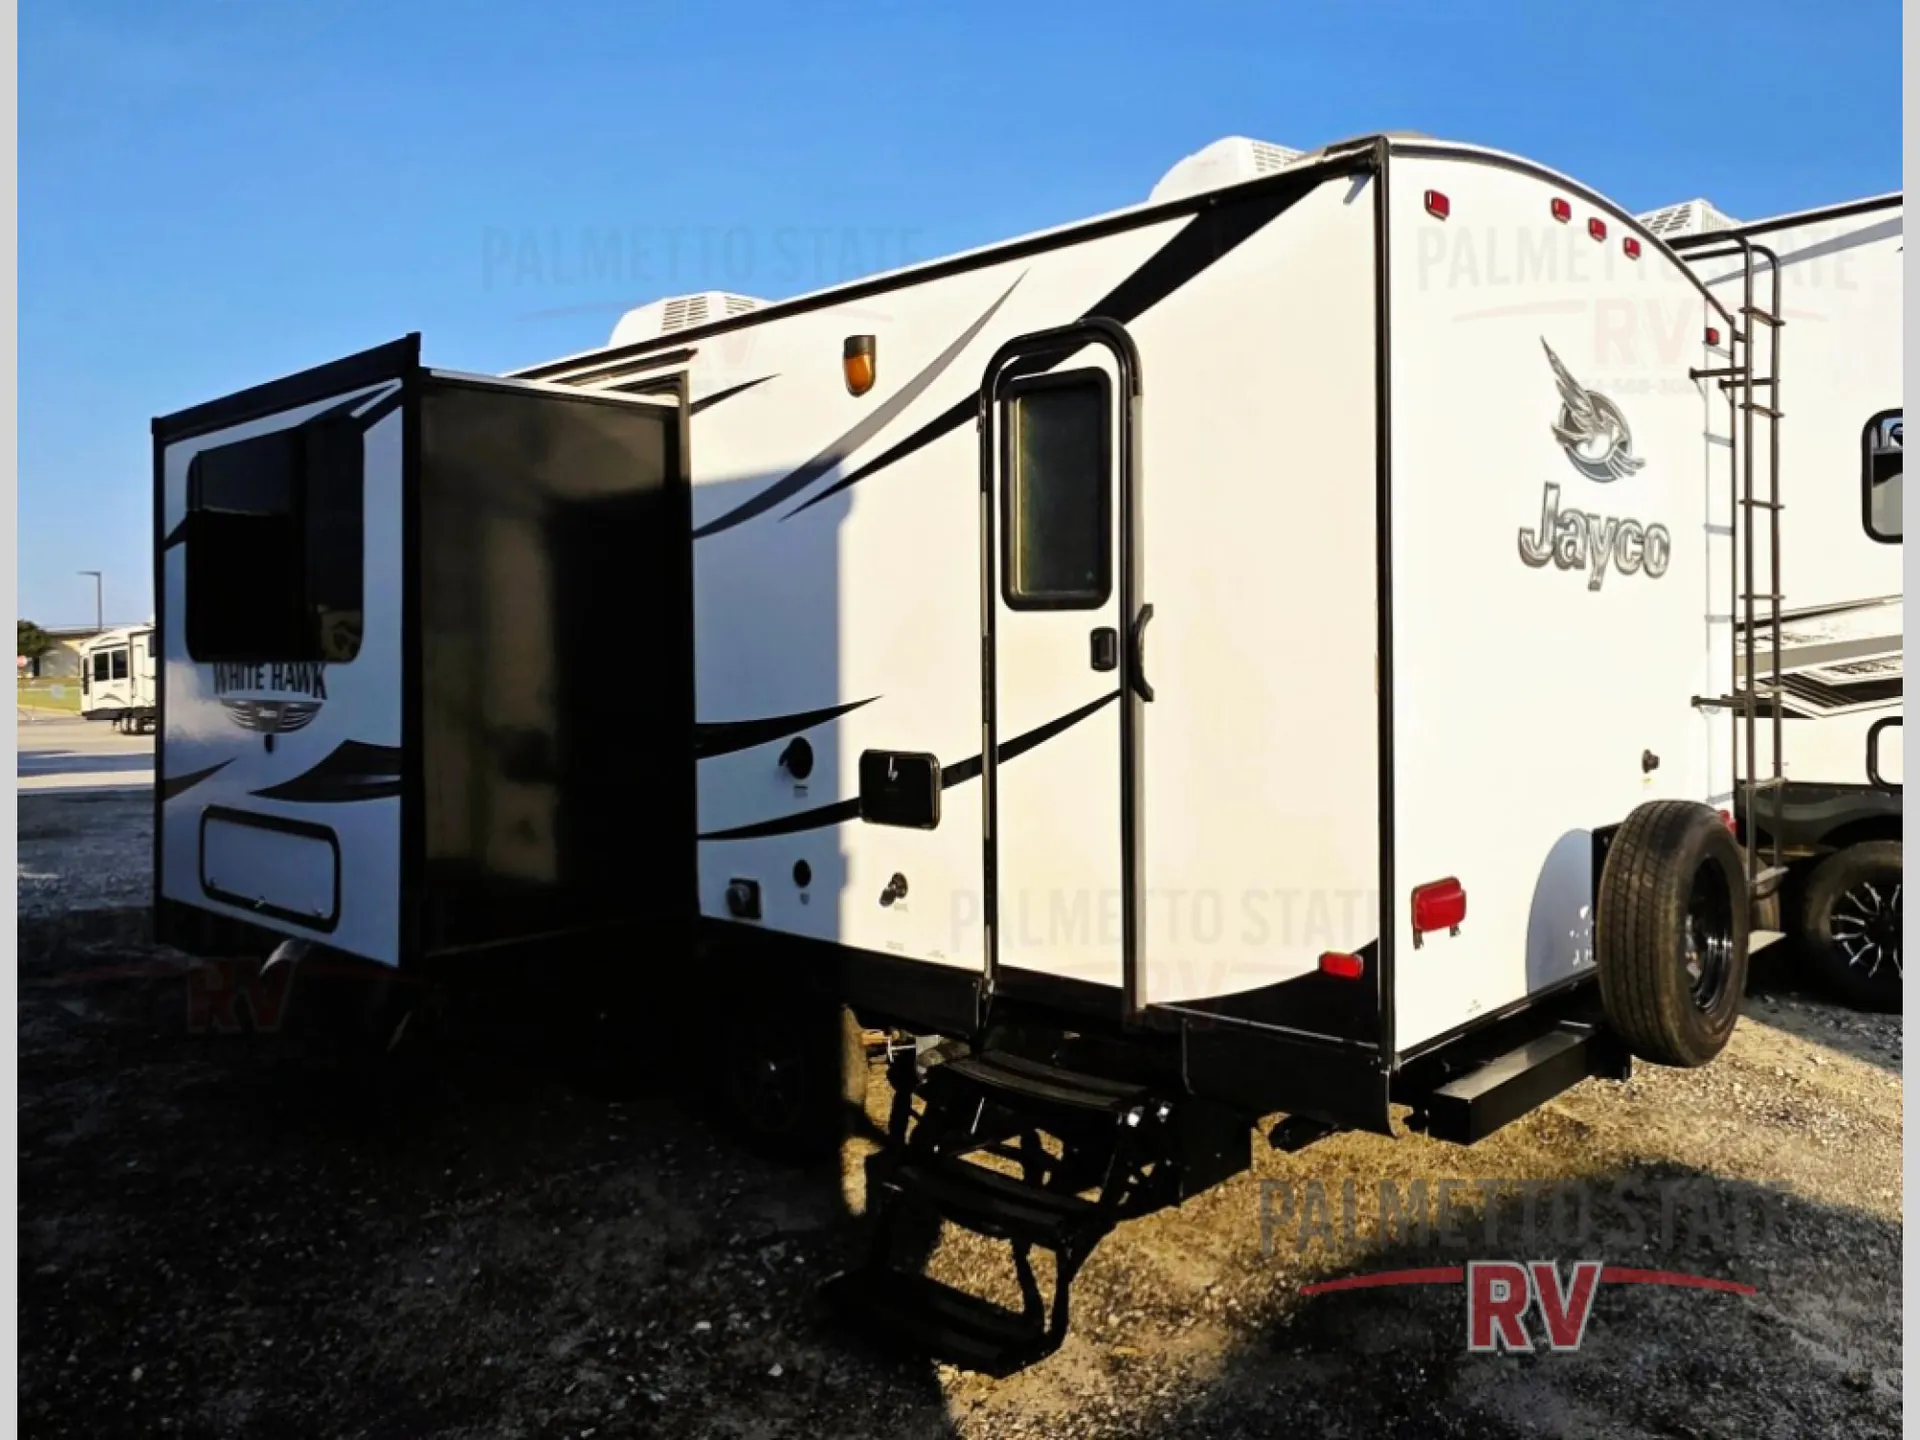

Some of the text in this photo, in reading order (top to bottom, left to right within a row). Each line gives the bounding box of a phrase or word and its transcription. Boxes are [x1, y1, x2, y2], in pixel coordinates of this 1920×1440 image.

[1518, 480, 1671, 592] Jayco
[213, 661, 328, 700] WHITE HAWK
